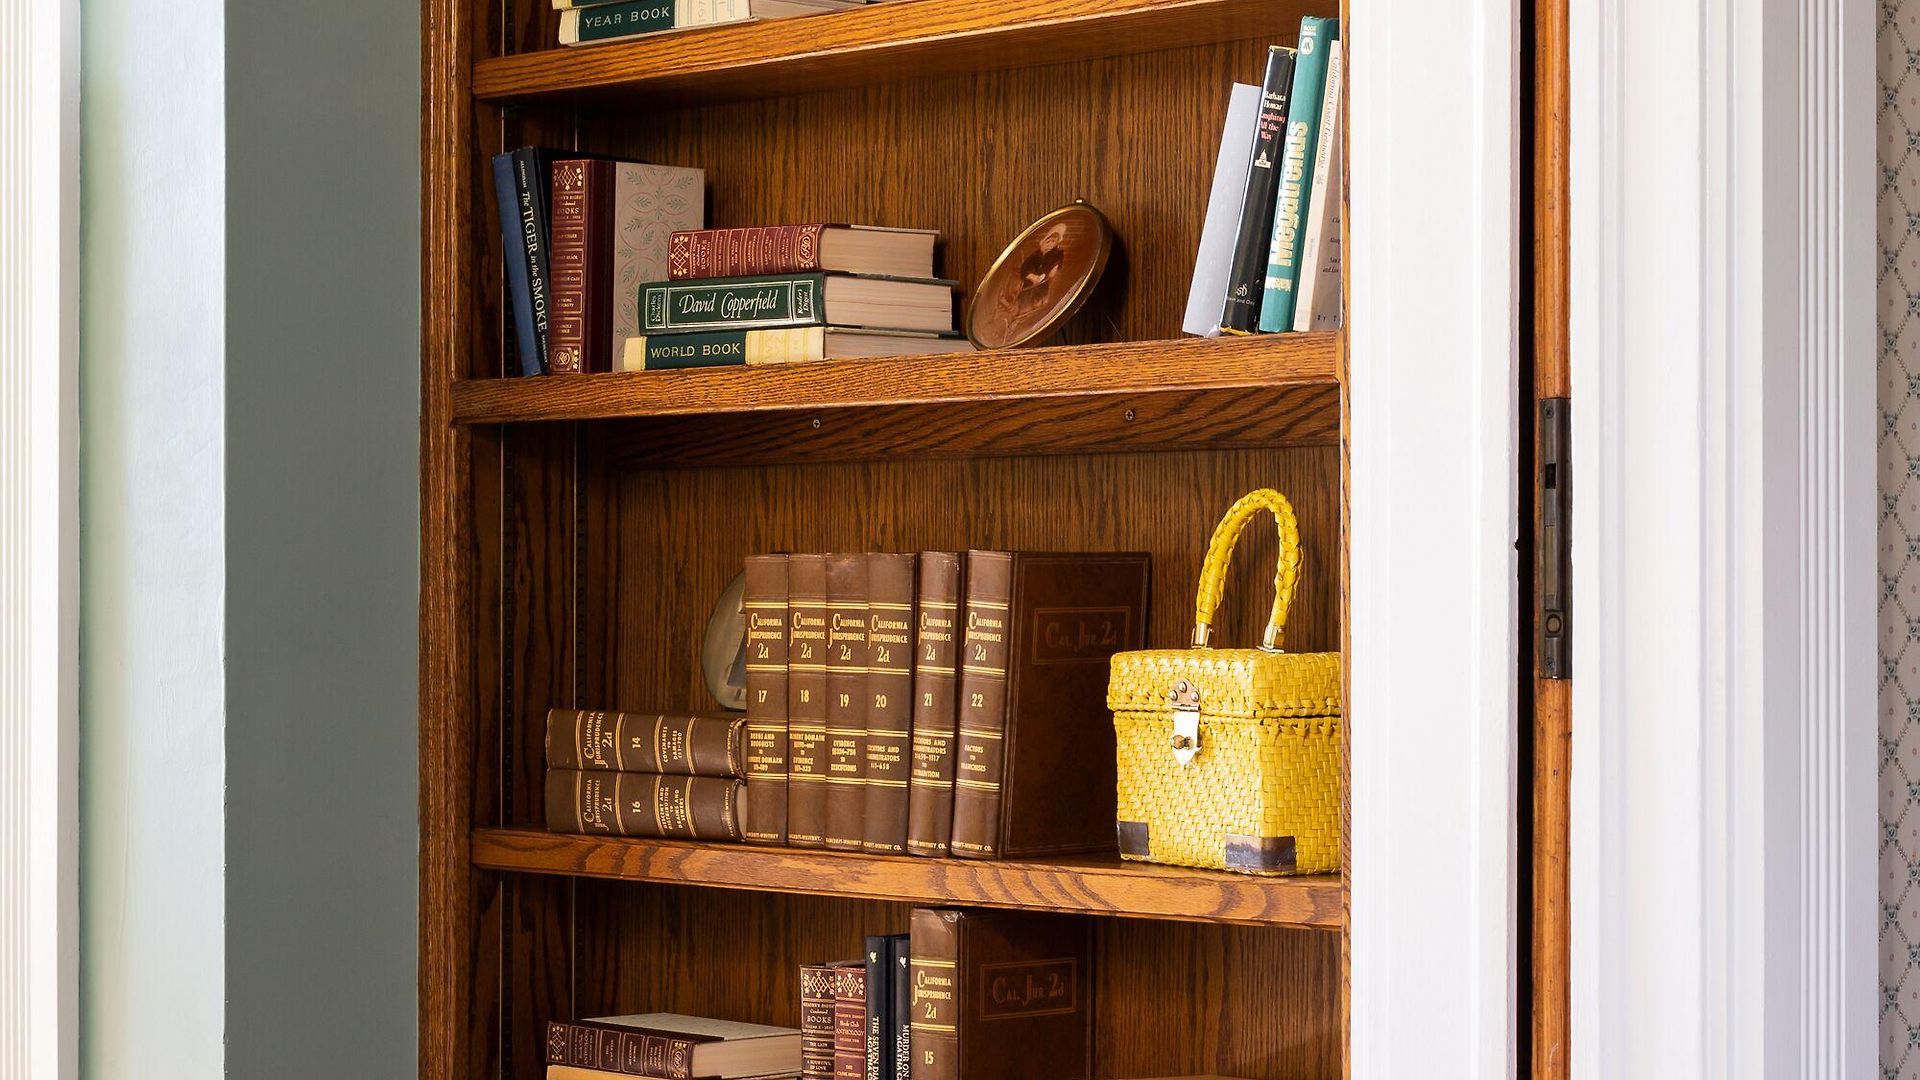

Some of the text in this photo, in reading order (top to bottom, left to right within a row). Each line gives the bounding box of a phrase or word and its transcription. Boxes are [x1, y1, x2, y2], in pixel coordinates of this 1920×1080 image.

[585, 6, 670, 28] YEAR BOOK
[1264, 90, 1286, 102] Barbara
[1263, 100, 1284, 111] Howar
[1268, 121, 1308, 267] Megatrends
[522, 191, 547, 333] The TIGER in the SMOKE
[678, 289, 778, 319] David Copperfield
[651, 342, 741, 359] WORLD BOOK
[751, 612, 782, 630] CALIFORNIA
[793, 612, 825, 629] CALIFORNIA
[832, 613, 865, 631] CALIFORNIA
[871, 614, 908, 632] CALIFORNIA
[921, 611, 952, 631] CALIFORNIA
[968, 611, 1002, 630] CALIFORNIA
[746, 627, 782, 648] JURISPRUDENCE
[789, 627, 825, 648] JURISPRUDENCE
[827, 628, 865, 649] JURISPRUDENCE
[867, 629, 908, 650] JURISPRUDENCE
[918, 627, 951, 647] JURISPRUDENCE
[964, 627, 1002, 647] JURISPRUDENCE
[757, 642, 769, 659] 2d
[800, 642, 812, 659] 2d
[840, 643, 851, 661] 2d
[877, 645, 890, 663] 2d
[925, 644, 936, 661] 2d
[974, 644, 987, 662] 2d
[758, 690, 768, 703] 17
[800, 690, 810, 703] 18
[840, 693, 850, 708] 19
[875, 694, 887, 708] 20
[924, 693, 933, 707] 21
[971, 693, 984, 708] 22
[583, 712, 596, 759] CALIFORNIA
[594, 712, 609, 769] JURISPRUDENCE
[601, 731, 613, 748] 2d
[631, 736, 641, 749] 14
[661, 726, 669, 763] COVENANTS
[933, 738, 946, 747] AND
[583, 779, 595, 823] CALIFORNIA
[594, 780, 609, 831] JURISPRUDENCE
[601, 797, 613, 812] 2d
[631, 800, 641, 814] 16
[663, 787, 673, 830] DISTRIBUTION
[659, 803, 668, 829] DESCENT
[674, 805, 683, 829] DRAINS
[917, 970, 952, 988] CALIFORNIA
[1049, 972, 1064, 998] 2d
[912, 984, 952, 1006] JURISPRUDENCE
[806, 1015, 832, 1024] BOOKS
[924, 1002, 937, 1019] 2d
[872, 1016, 880, 1080] THE SEVEN DIA
[902, 1024, 910, 1077] MURDER ON
[924, 1050, 934, 1065] 15
